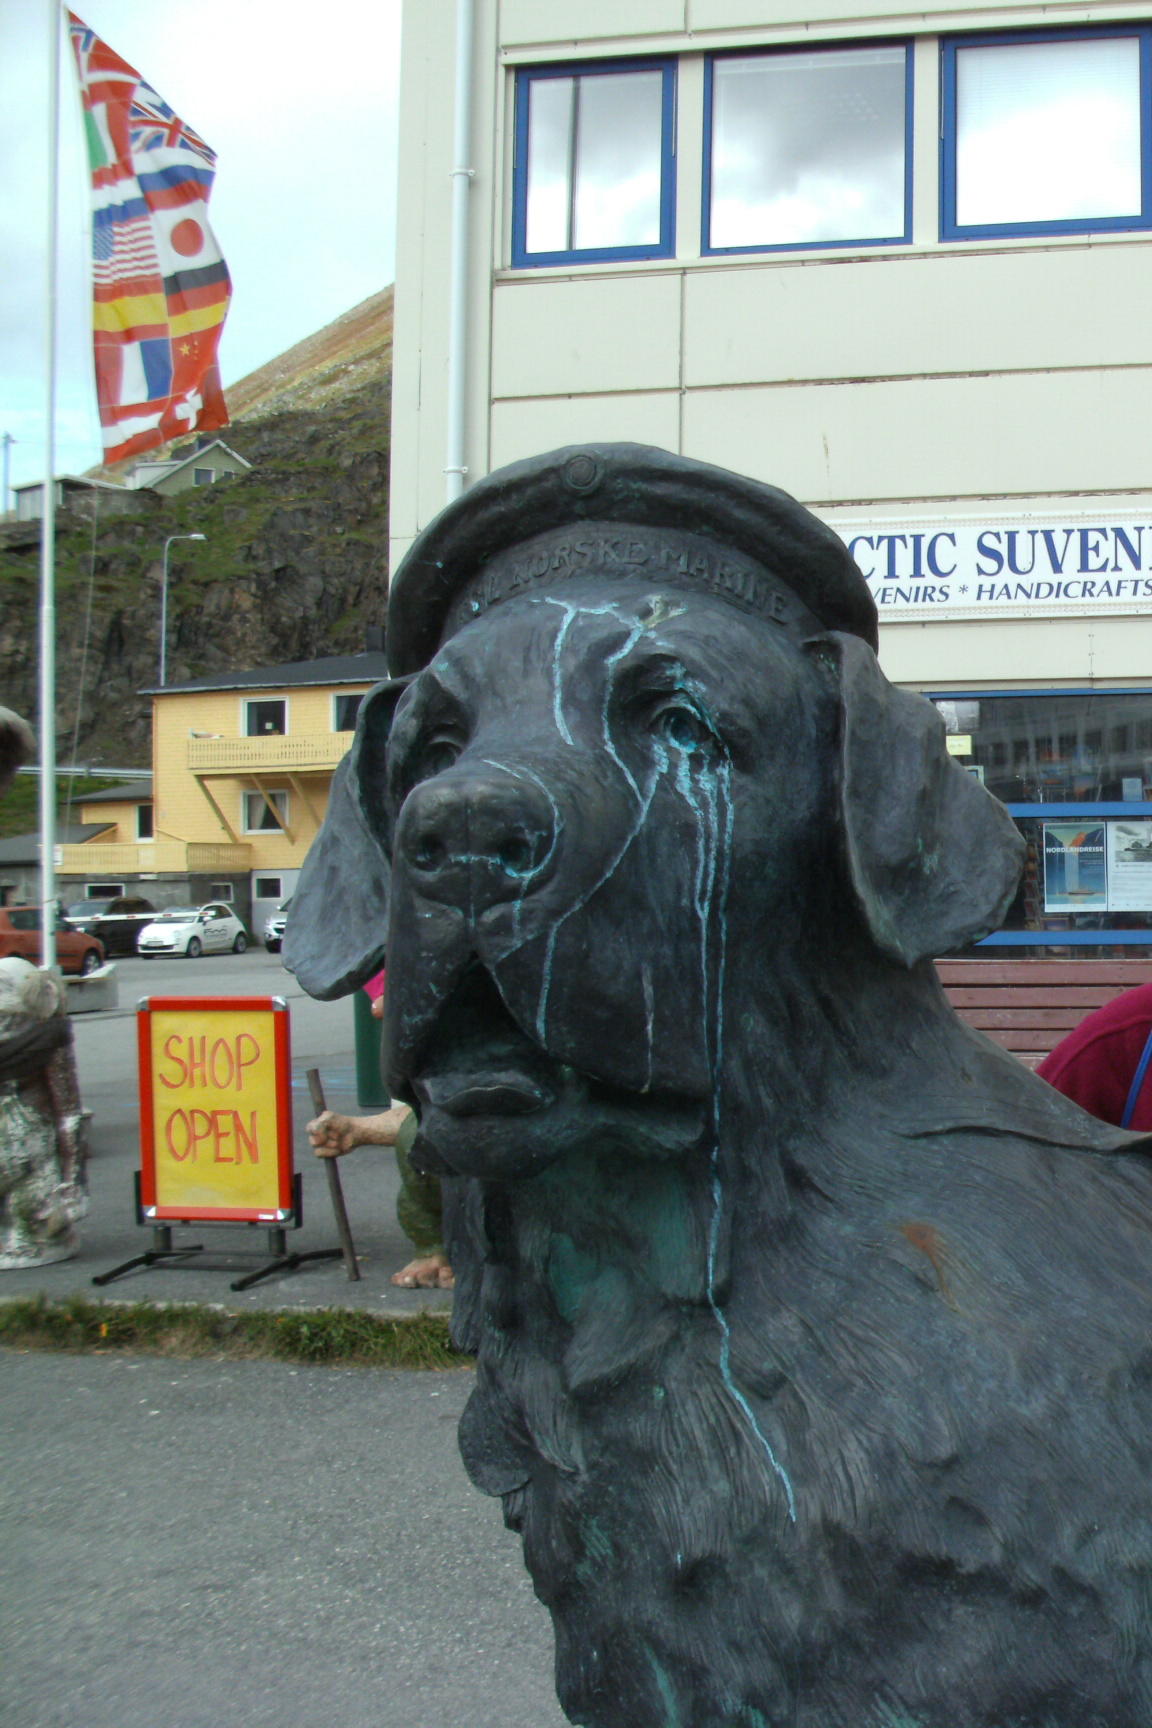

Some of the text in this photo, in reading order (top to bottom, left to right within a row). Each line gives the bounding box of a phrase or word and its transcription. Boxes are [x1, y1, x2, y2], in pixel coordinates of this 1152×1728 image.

[508, 540, 649, 589] NORSKE
[658, 548, 789, 626] MARINE
[1045, 846, 1104, 854] NORDLANDREISE
[158, 1032, 261, 1092] SHOP
[165, 1107, 259, 1166] OPEN
